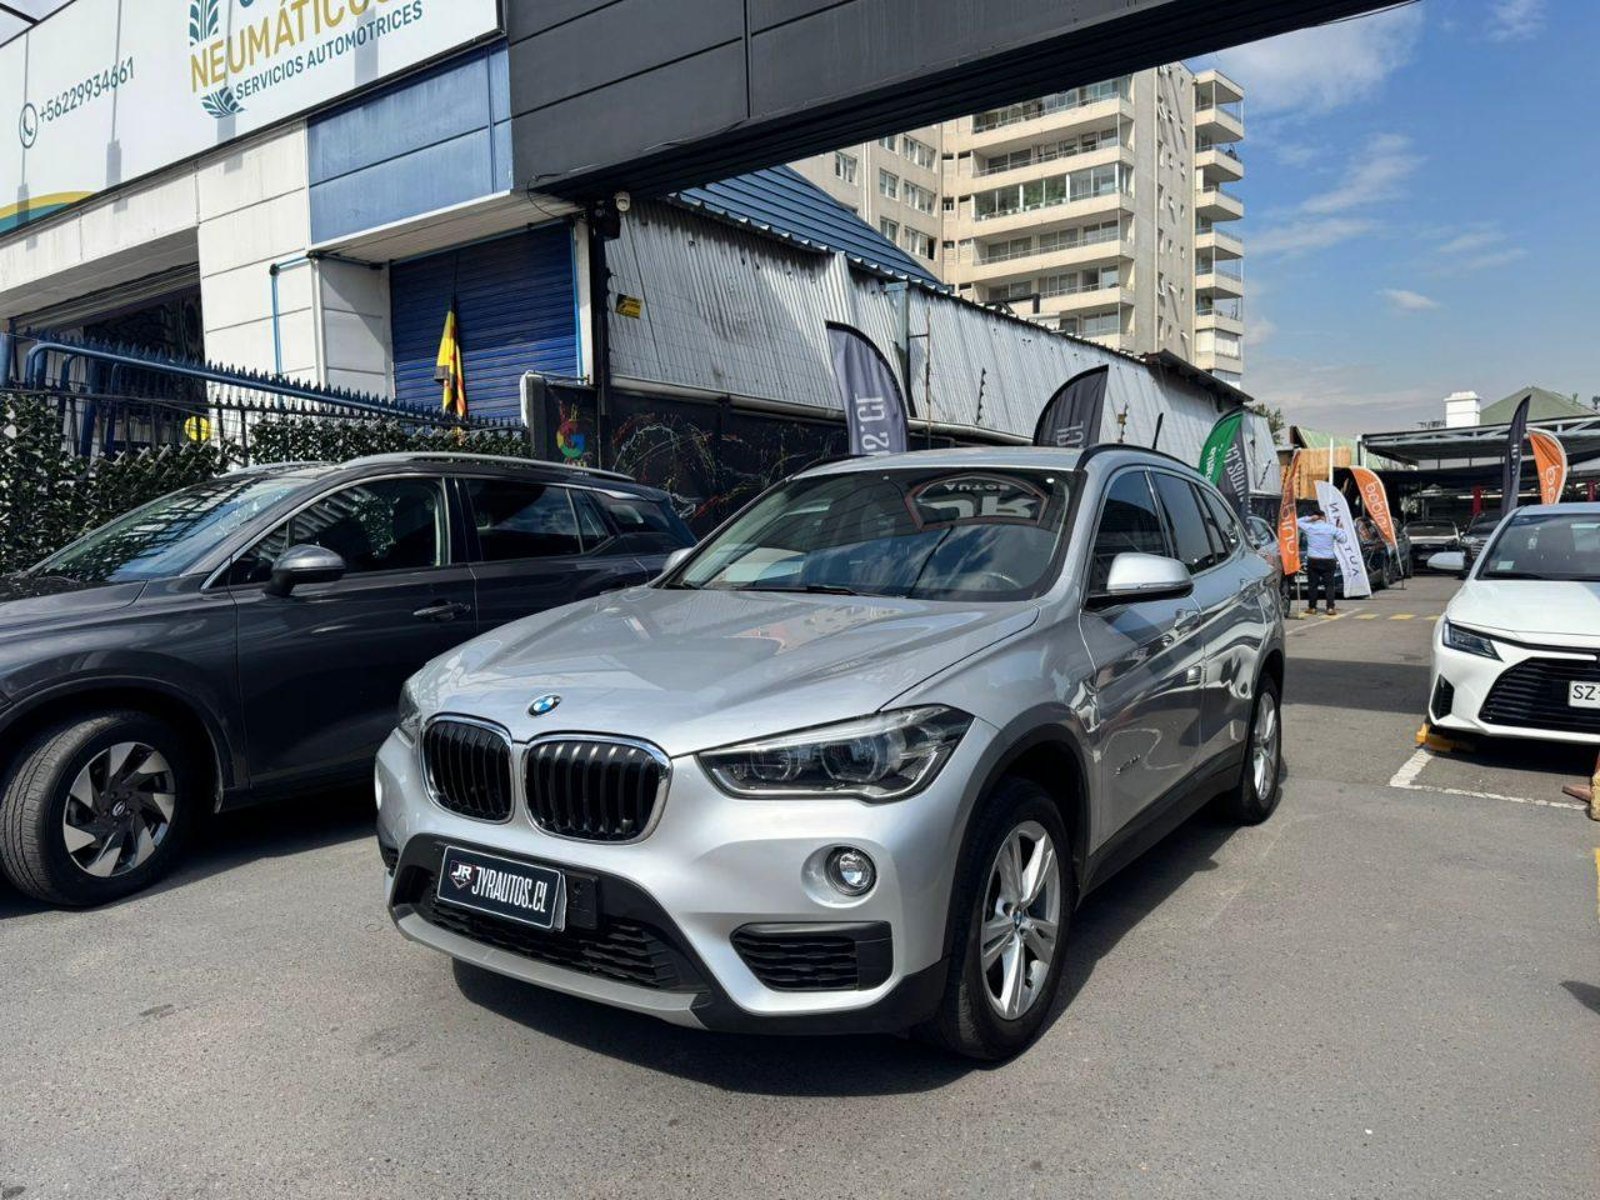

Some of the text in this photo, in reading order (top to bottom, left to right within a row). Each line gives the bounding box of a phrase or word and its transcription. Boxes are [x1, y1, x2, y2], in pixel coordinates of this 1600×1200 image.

[191, 0, 391, 94] NEUMÁTIC
[235, 0, 423, 101] SERVICIOS AUTOMOTRICES
[39, 56, 134, 123] +56229934661
[471, 866, 548, 913] JYRAUTOS.CL
